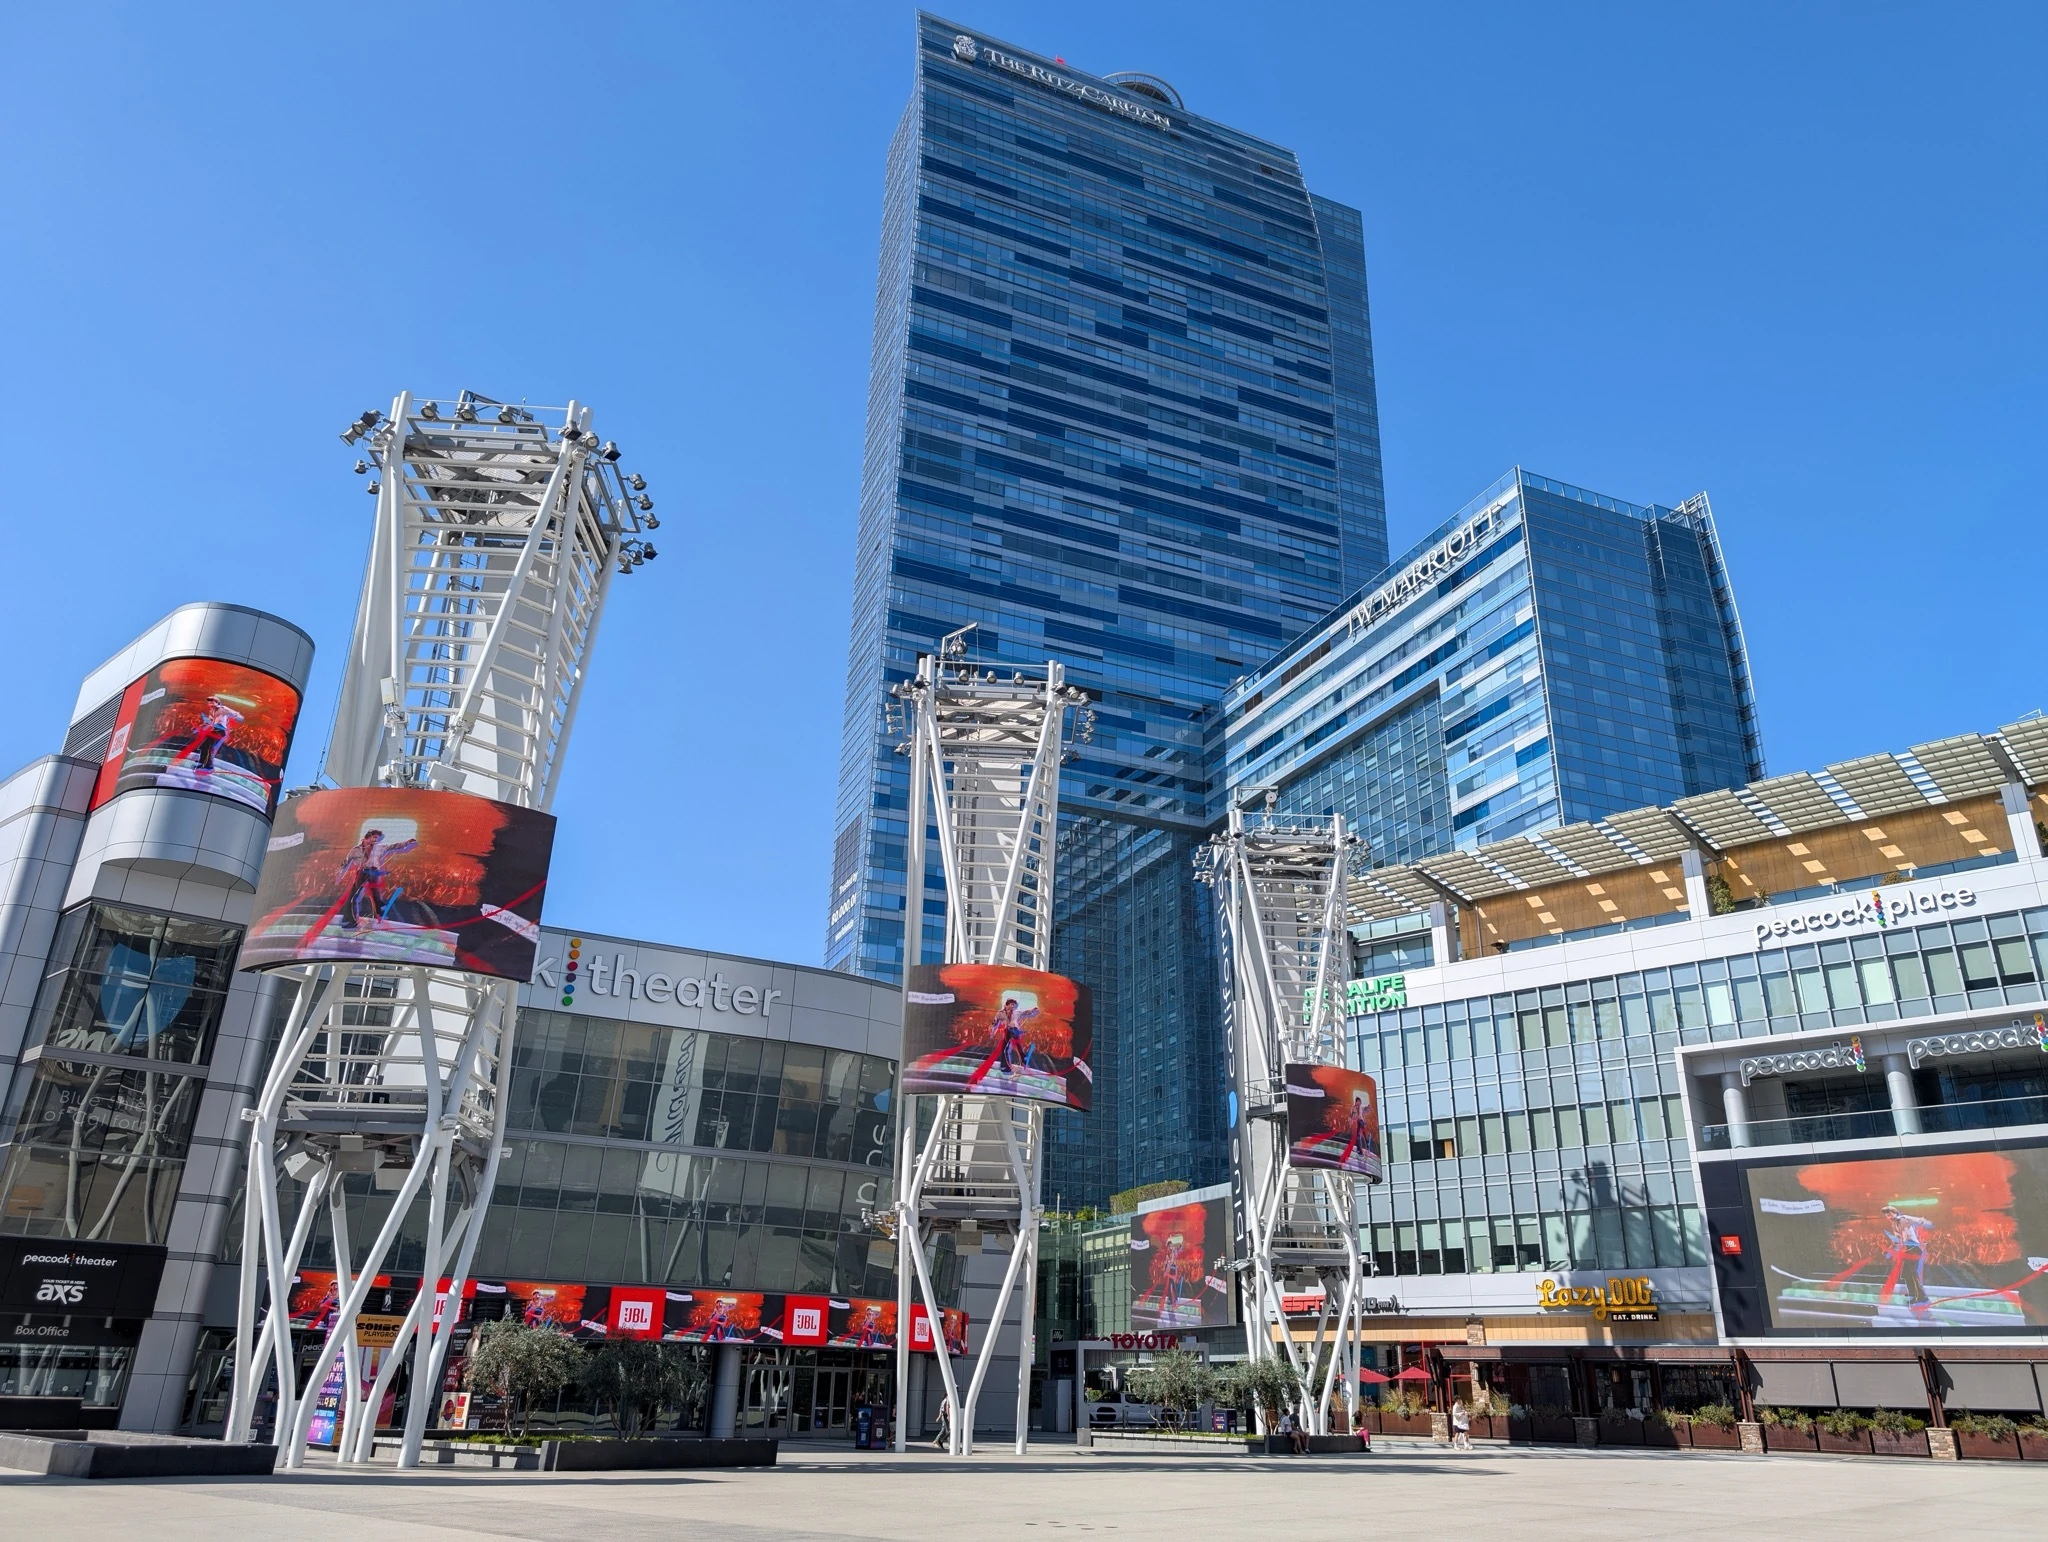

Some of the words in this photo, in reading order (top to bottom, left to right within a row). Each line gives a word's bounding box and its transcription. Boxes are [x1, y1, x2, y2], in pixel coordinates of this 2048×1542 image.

[984, 47, 1026, 73] THE
[1347, 598, 1376, 638] JW
[1379, 506, 1503, 611] MARRIOTT
[1752, 897, 1873, 950] peacock
[1886, 886, 1977, 924] place
[586, 953, 782, 1018] theater
[1217, 872, 1236, 1079] california
[1304, 974, 1405, 1001] HALIFE
[1302, 991, 1406, 1026] NITION
[1907, 1020, 2037, 1070] peacock
[1739, 1040, 1851, 1087] peacock
[59, 1090, 101, 1108] Blue
[43, 1108, 67, 1122] of
[1232, 1138, 1244, 1242] blue
[22, 1254, 70, 1265] peacock
[76, 1255, 118, 1267] theater
[1536, 1279, 1607, 1321] Lazy
[1607, 1275, 1652, 1306] DOG
[624, 1307, 648, 1324] JBL
[797, 1314, 817, 1330] JBL
[916, 1322, 929, 1336] JBL
[15, 1325, 36, 1336] Box
[37, 1326, 70, 1337] Office
[1111, 1333, 1180, 1350] TOYOTA
